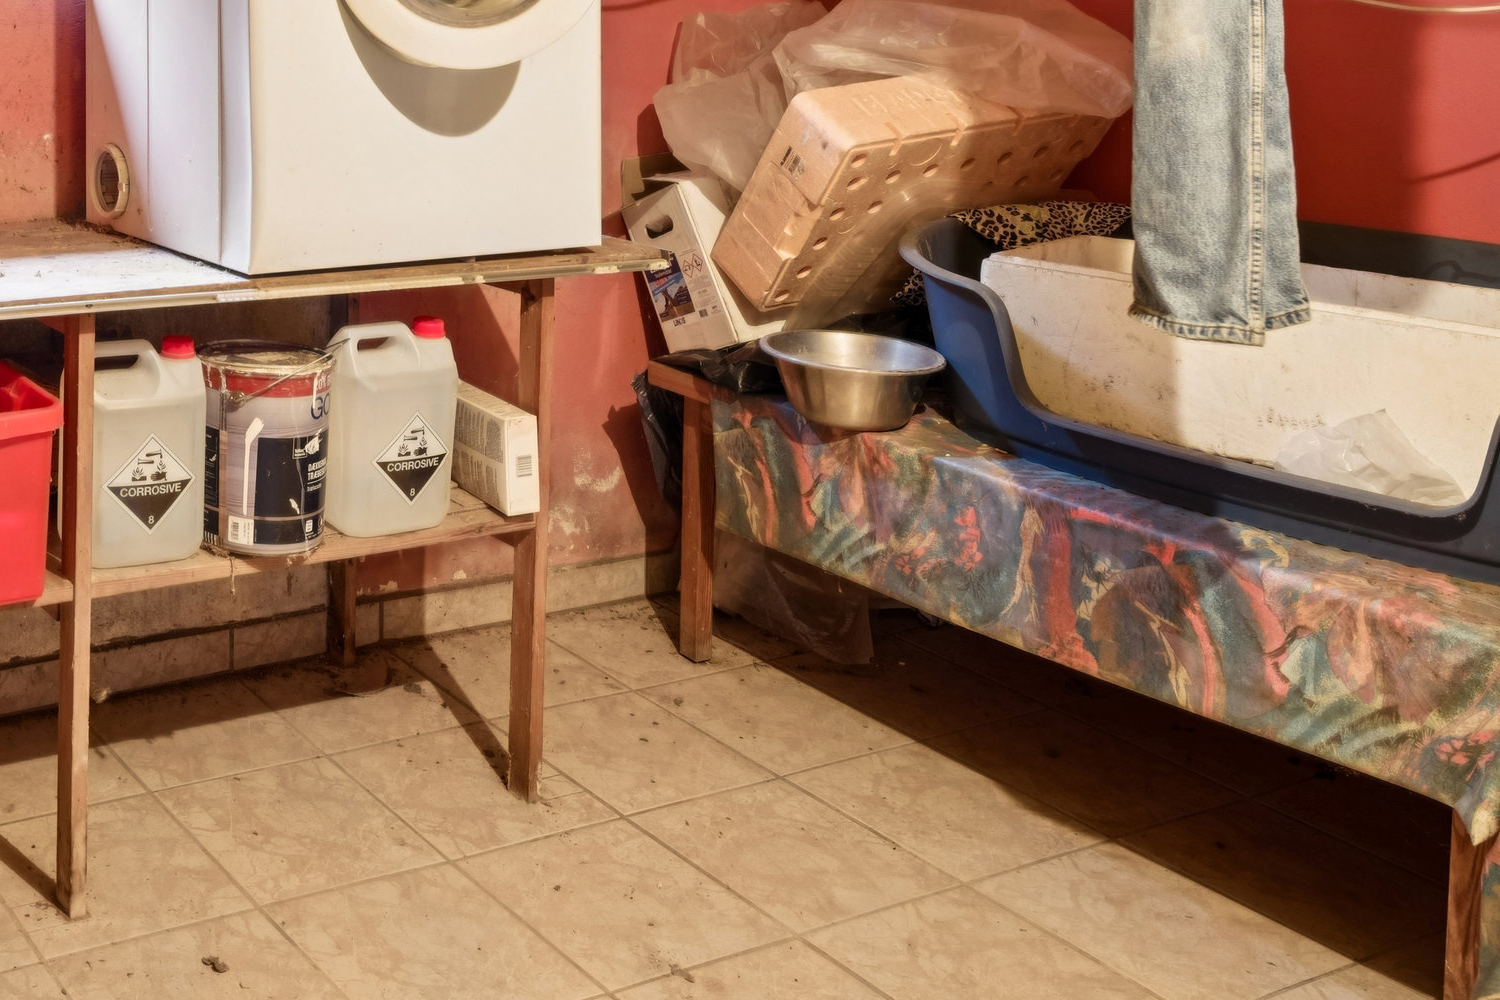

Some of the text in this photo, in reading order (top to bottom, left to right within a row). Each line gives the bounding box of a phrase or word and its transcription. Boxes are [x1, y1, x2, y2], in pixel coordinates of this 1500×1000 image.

[383, 457, 439, 472] CORROSIVE
[120, 482, 182, 498] CORROSIVE
[410, 488, 415, 496] 8
[148, 515, 155, 524] 8
